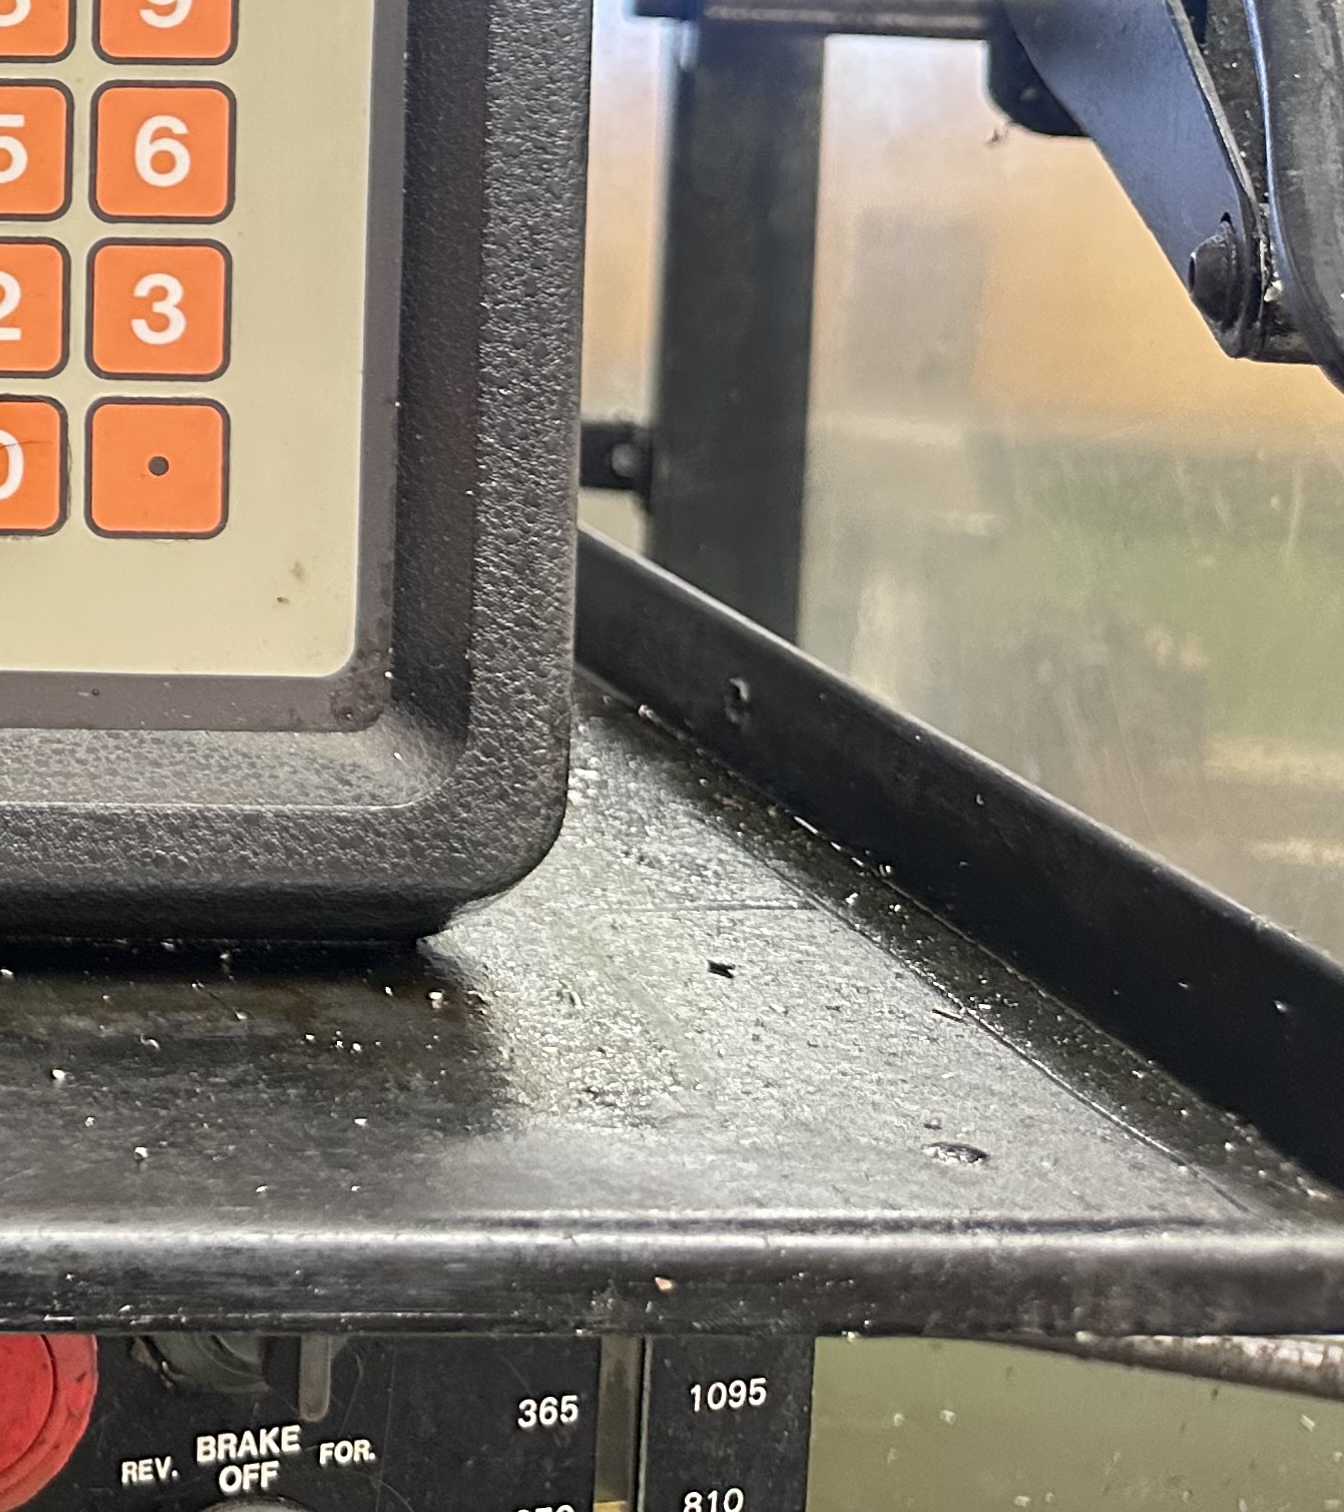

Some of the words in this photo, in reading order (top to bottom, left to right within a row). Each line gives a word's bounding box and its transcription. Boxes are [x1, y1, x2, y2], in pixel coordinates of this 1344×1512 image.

[134, 114, 192, 188] 6
[130, 272, 188, 346] 3
[516, 1393, 580, 1430] 365
[689, 1376, 769, 1413] 1095
[195, 1424, 302, 1463] BRAKE
[318, 1439, 377, 1465] FOR.
[120, 1455, 180, 1485] REV.
[218, 1460, 280, 1493] OFF
